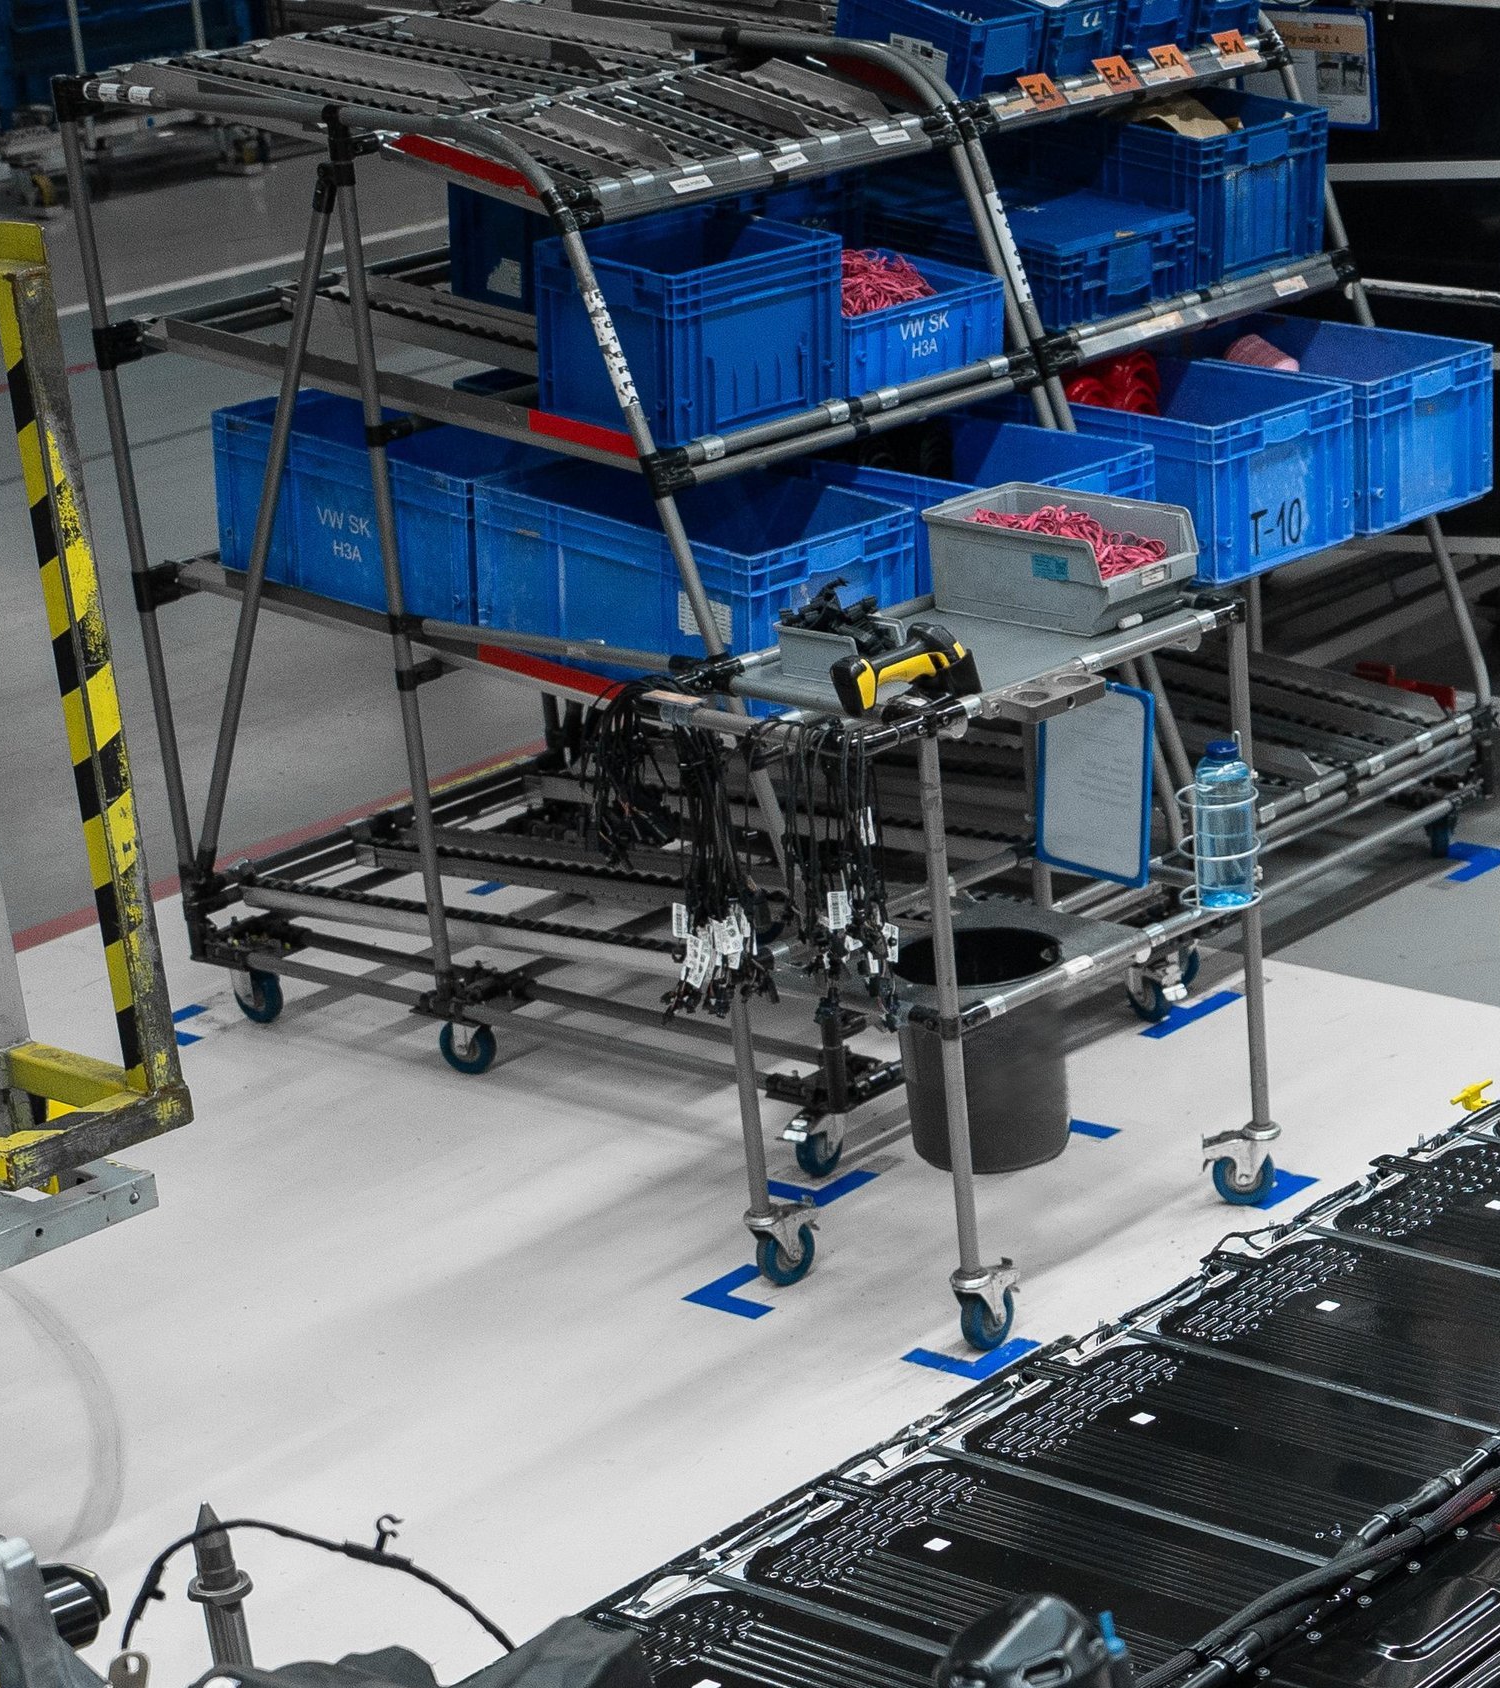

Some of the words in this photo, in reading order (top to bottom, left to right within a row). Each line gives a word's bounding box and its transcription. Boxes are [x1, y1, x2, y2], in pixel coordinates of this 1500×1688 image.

[1101, 65, 1132, 86] E4
[1024, 83, 1055, 104] E4
[899, 317, 926, 342] VW
[928, 310, 950, 334] SK
[911, 337, 938, 359] H3A
[316, 504, 344, 530] VW
[348, 514, 372, 538] SK
[1250, 497, 1302, 557] T-10
[332, 539, 362, 563] H3A
